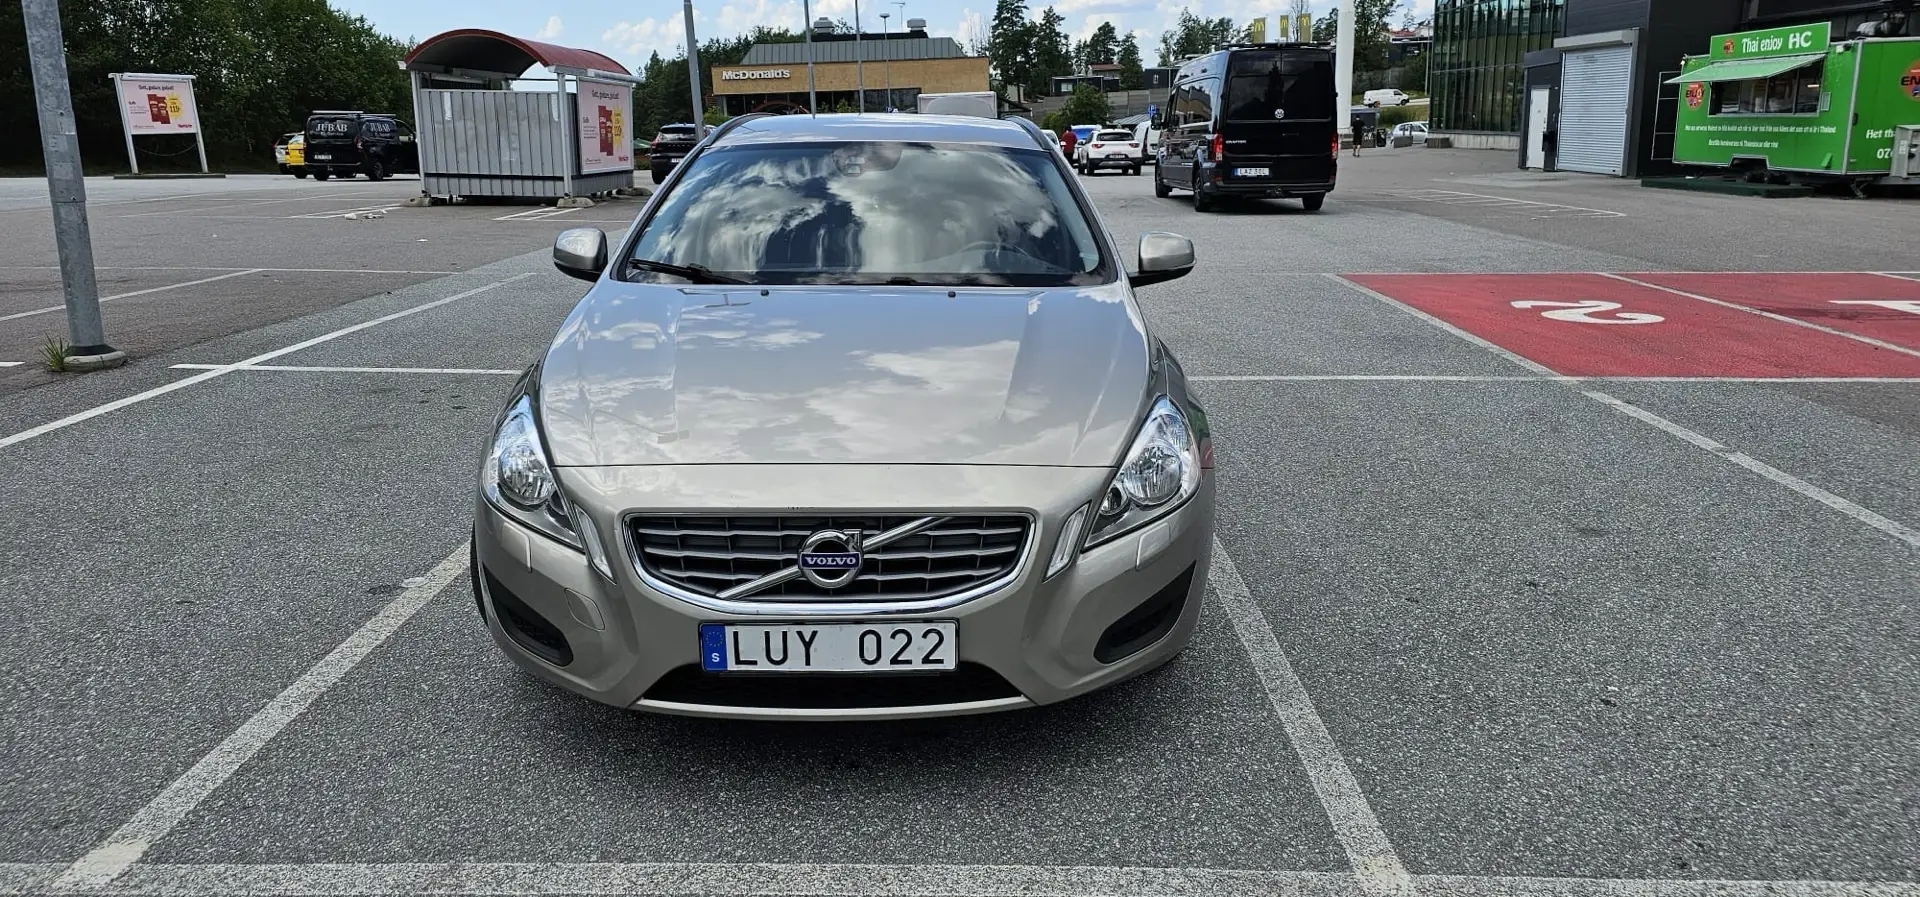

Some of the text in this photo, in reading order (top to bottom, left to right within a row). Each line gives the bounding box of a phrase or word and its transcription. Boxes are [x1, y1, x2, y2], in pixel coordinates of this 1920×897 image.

[1742, 37, 1759, 53] Thai
[1761, 36, 1783, 52] enjoy
[1788, 31, 1812, 49] HC
[722, 69, 791, 80] McDonald's
[316, 123, 348, 132] JUBAB
[1866, 129, 1883, 139] Het
[1510, 300, 1665, 325] 2
[805, 557, 857, 565] VOLVO
[712, 628, 946, 666] S LUY 022
